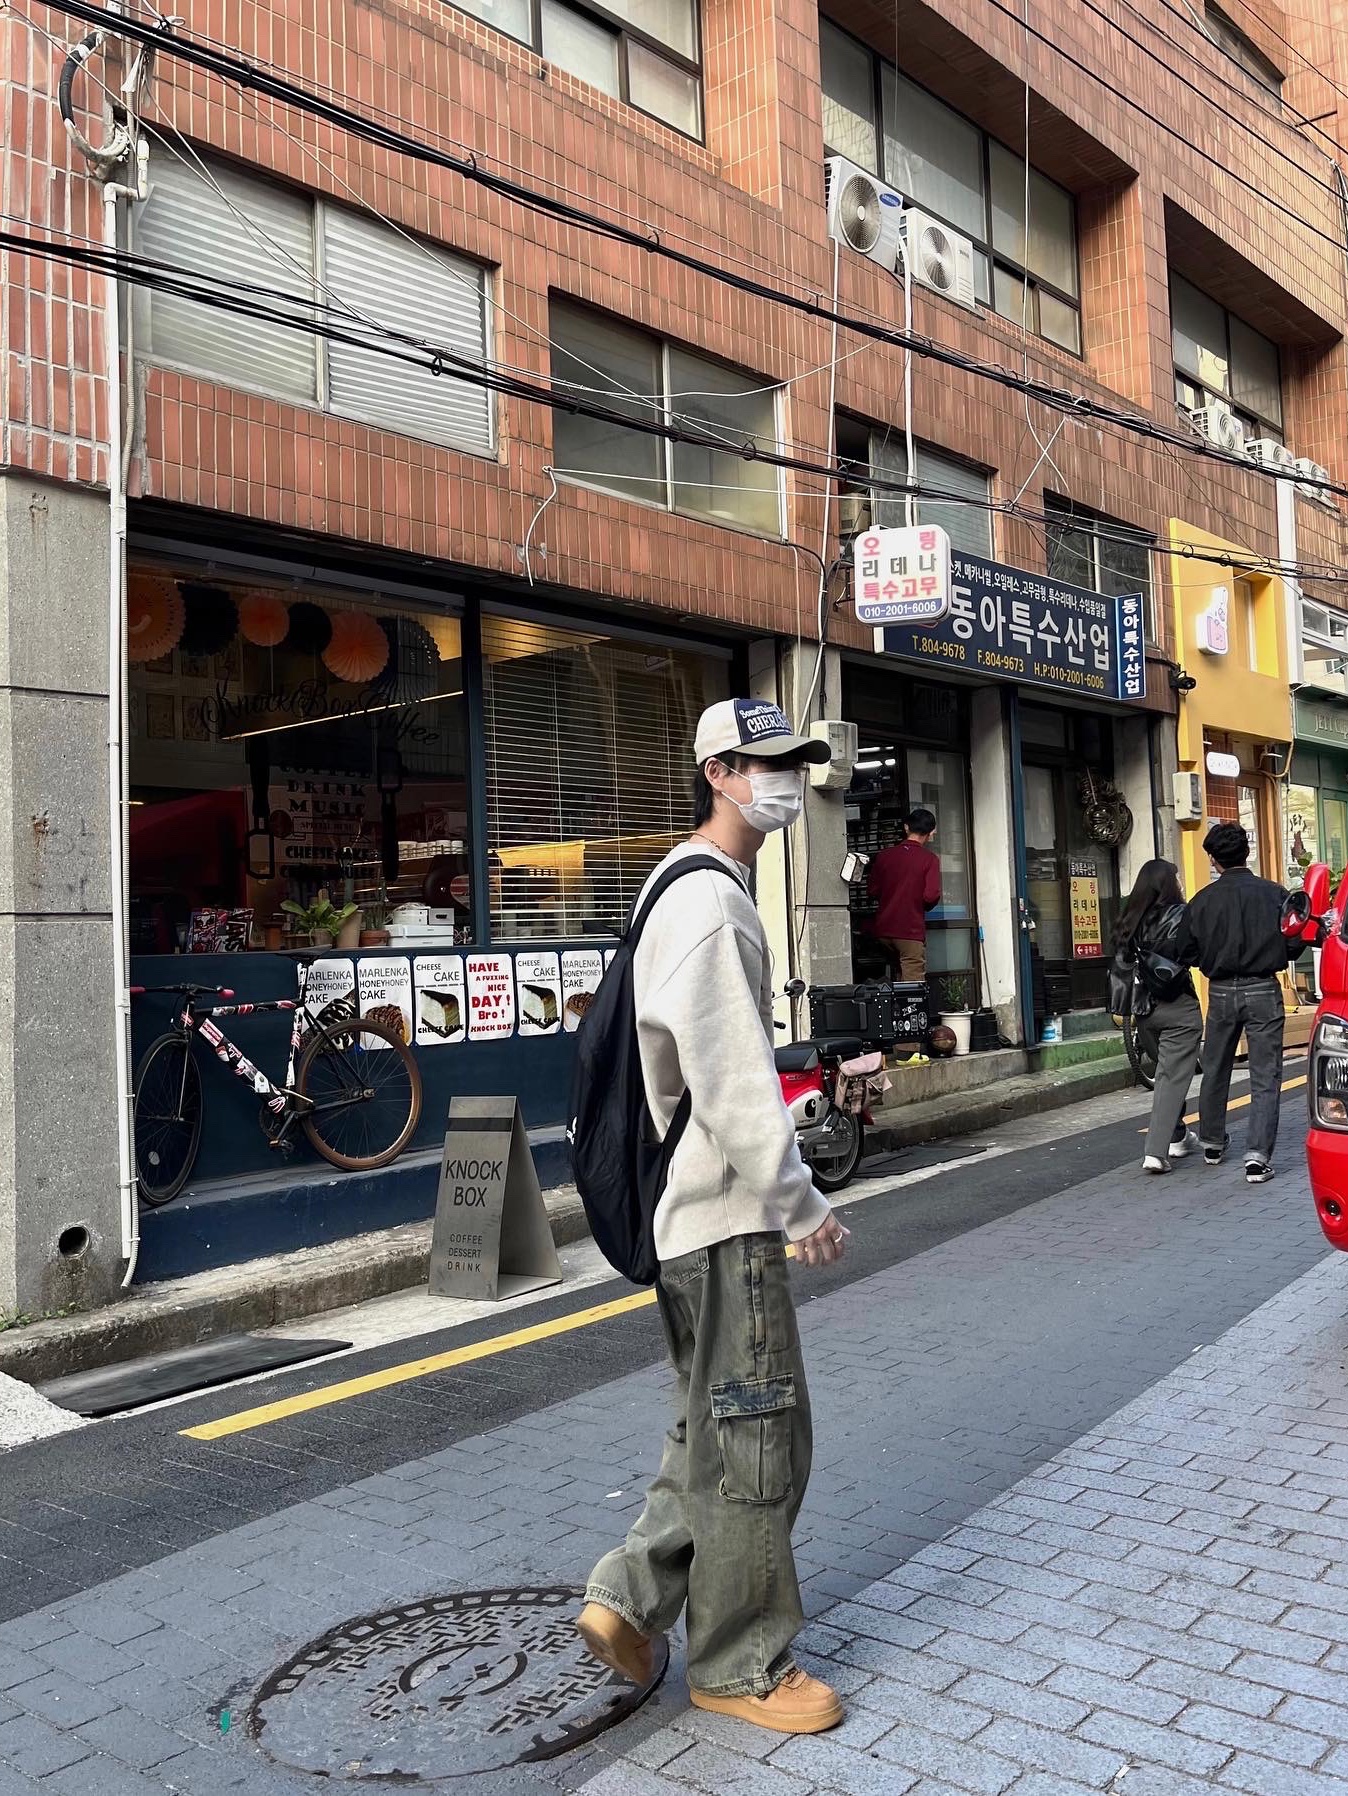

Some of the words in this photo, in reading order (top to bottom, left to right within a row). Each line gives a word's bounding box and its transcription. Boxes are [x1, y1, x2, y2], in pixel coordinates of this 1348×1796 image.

[864, 577, 938, 601] 특수고무
[864, 601, 937, 618] 010-2001-6006
[951, 585, 1110, 671] 동아특수산업
[1121, 598, 1142, 695] 동아특수산업
[912, 635, 966, 661] T.804-9678
[977, 649, 1025, 673] F.804-9673
[416, 963, 441, 971] CHEESE
[468, 962, 499, 973] HAVE
[562, 959, 601, 968] MARLENKA
[308, 970, 353, 981] ARLENKA
[359, 967, 408, 978] MARLENKA
[434, 971, 460, 982] CAKE
[533, 967, 556, 977] CAKE
[306, 982, 353, 992] ONEYHONEY
[487, 984, 506, 992] NICE
[563, 979, 584, 988] CAKE
[360, 990, 386, 1000] CAKE
[470, 1024, 496, 1033] KNOCK
[497, 1023, 512, 1031] BOX
[445, 1160, 503, 1181] KNOCK
[453, 1186, 488, 1207] BOX
[450, 1233, 483, 1245] COFFEE
[448, 1247, 482, 1259] DESSERT
[447, 1261, 481, 1273] DRINK
